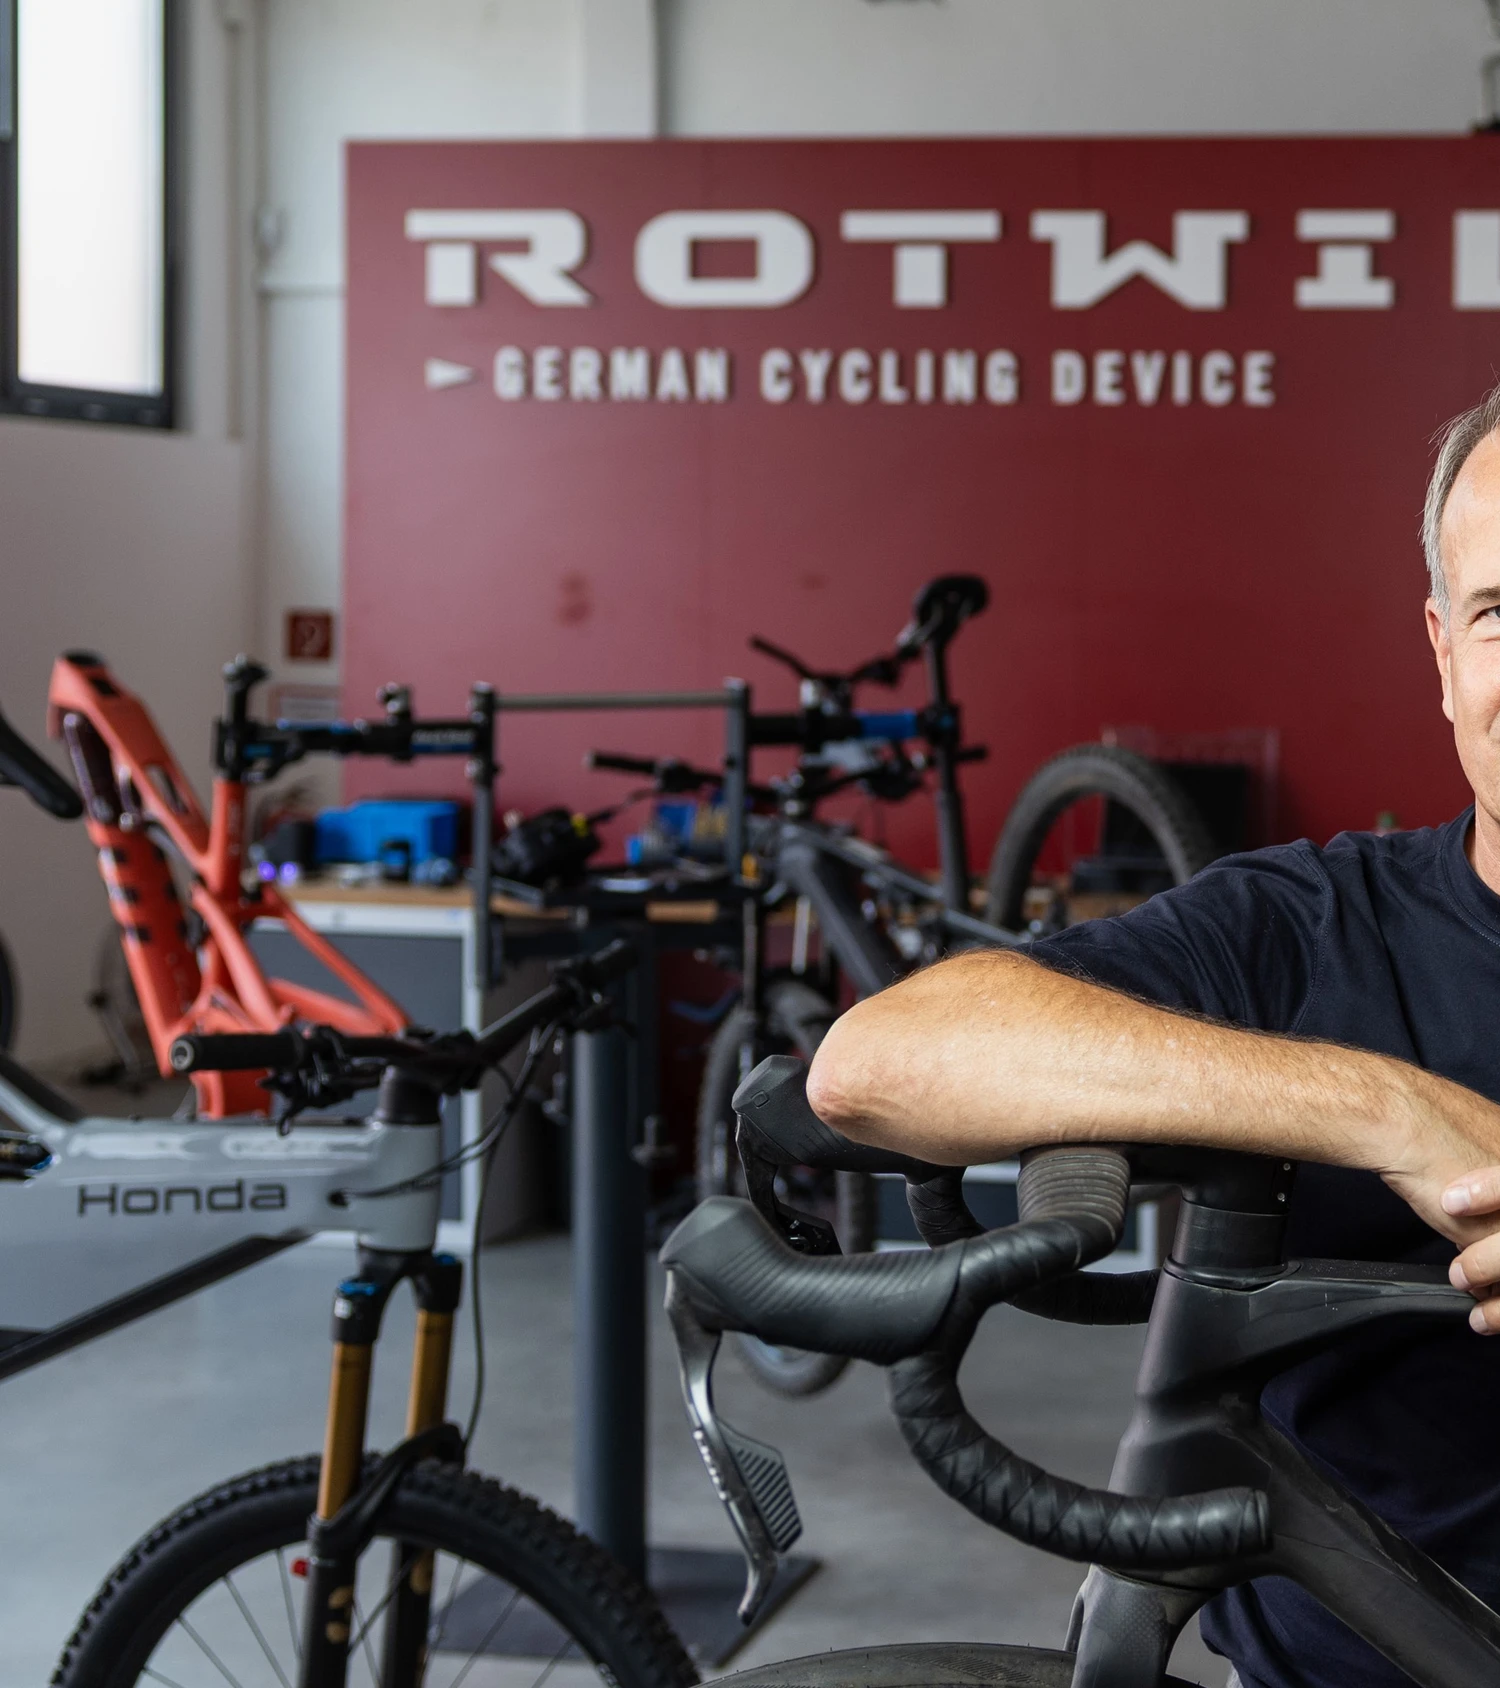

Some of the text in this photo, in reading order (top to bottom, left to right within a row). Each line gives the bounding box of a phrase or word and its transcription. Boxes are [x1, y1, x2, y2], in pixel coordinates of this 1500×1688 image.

[493, 346, 1275, 405] GERMAN CYCLING DEVICE
[77, 1178, 288, 1216] Honda
